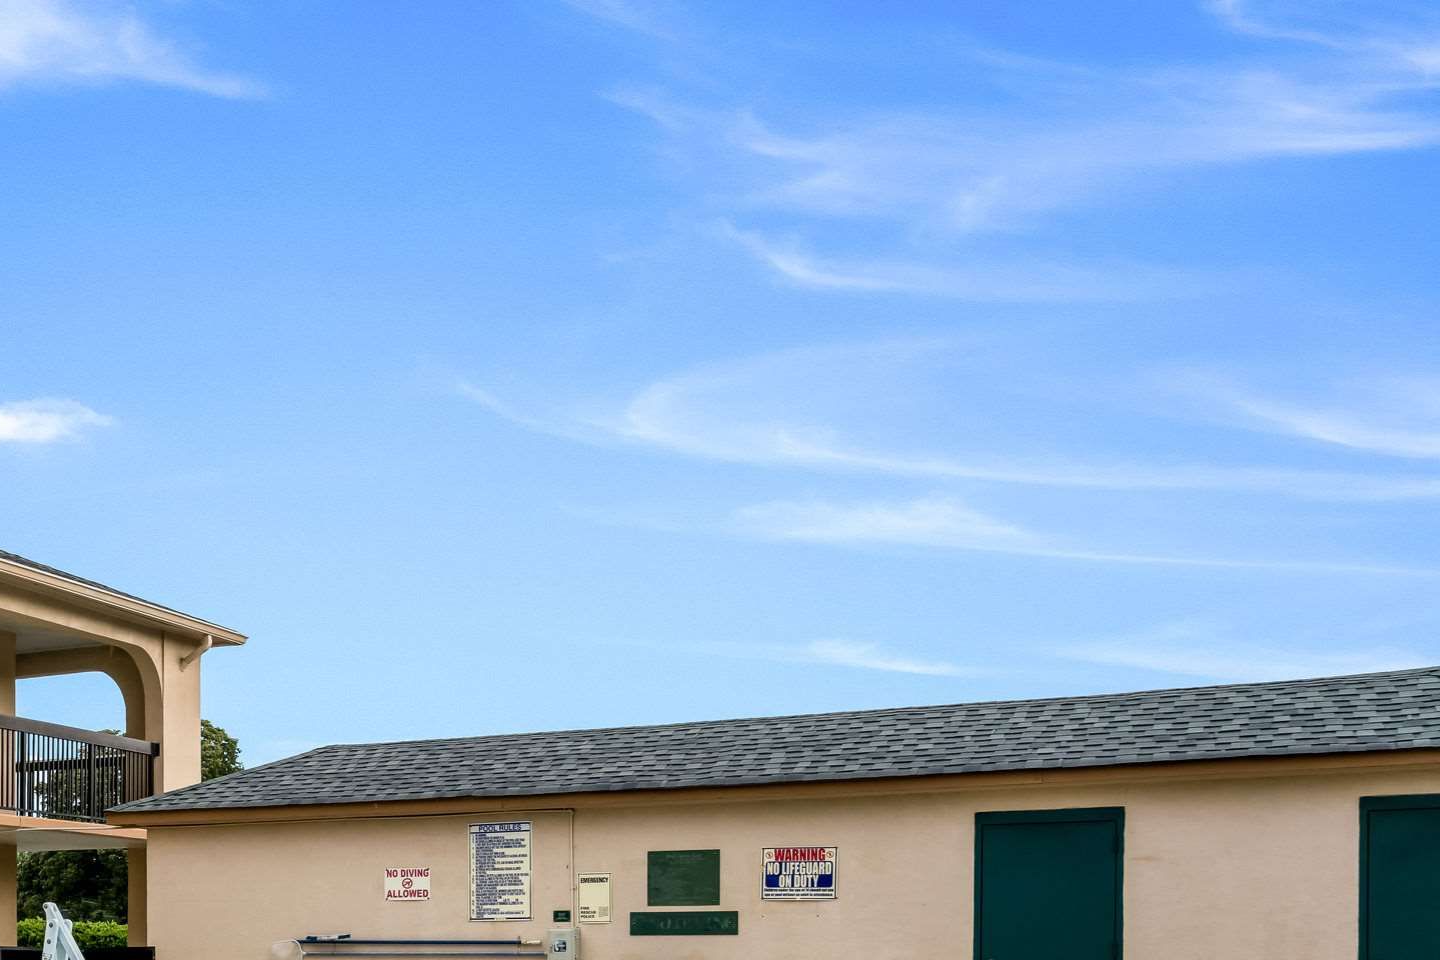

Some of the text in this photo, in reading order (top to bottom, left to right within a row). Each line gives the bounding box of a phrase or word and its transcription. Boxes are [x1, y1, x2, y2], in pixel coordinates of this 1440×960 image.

[499, 824, 522, 832] RULES
[775, 848, 826, 862] WARNING
[386, 868, 429, 878] NO DIVING
[766, 862, 832, 875] NO LIFEGUARD
[778, 875, 819, 888] ON DUTY
[386, 889, 429, 898] ALLOWED
